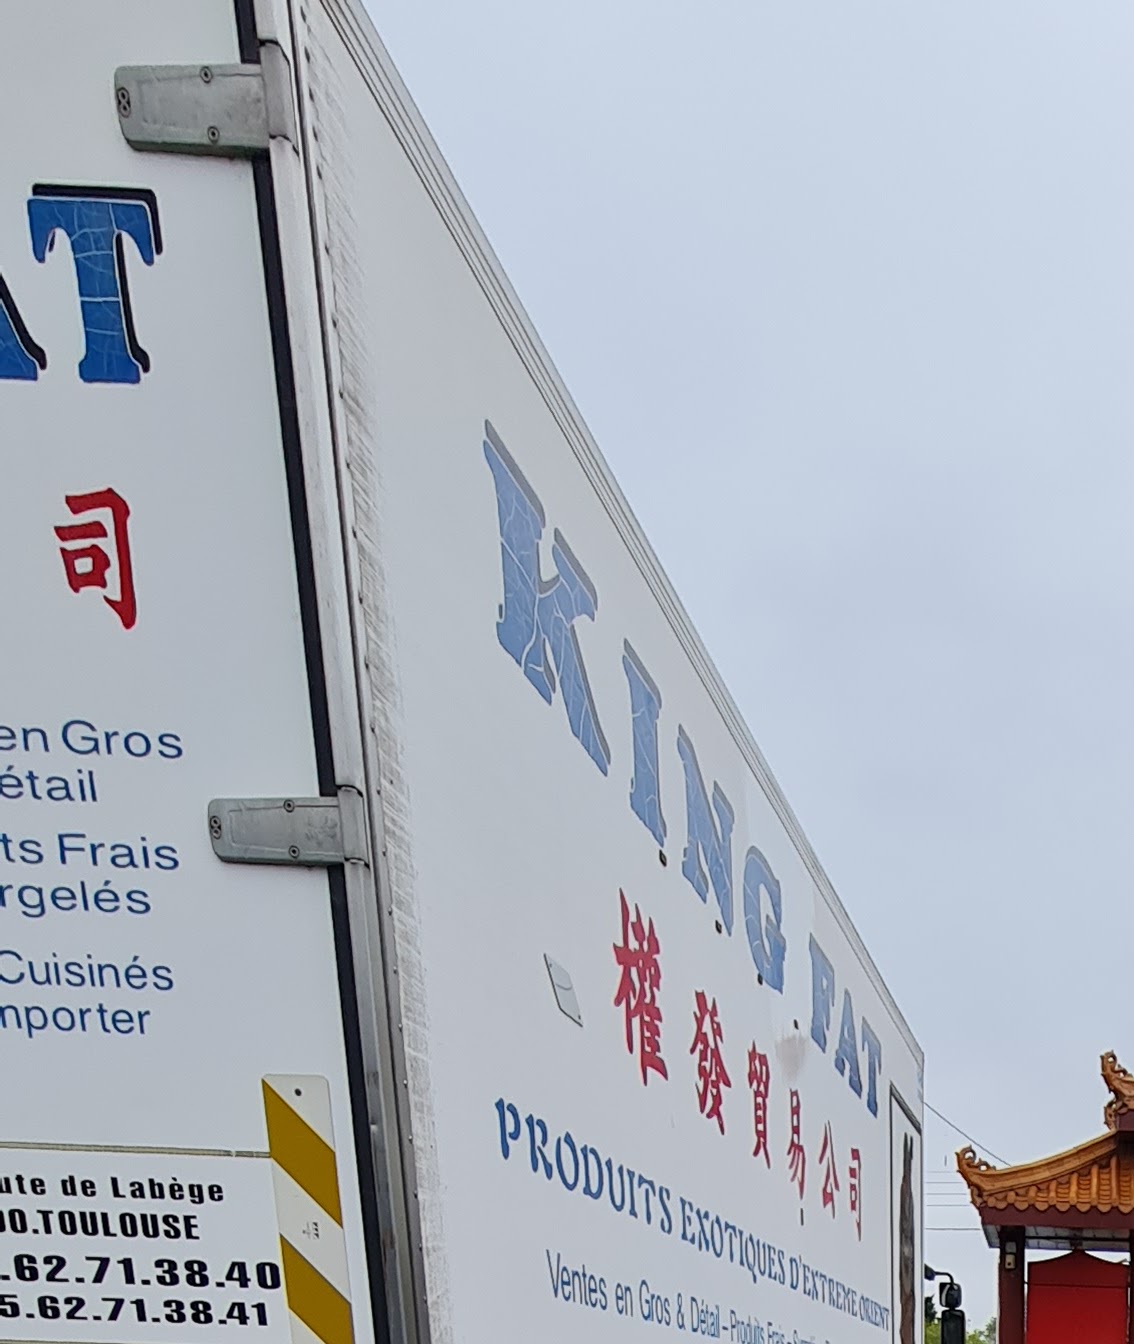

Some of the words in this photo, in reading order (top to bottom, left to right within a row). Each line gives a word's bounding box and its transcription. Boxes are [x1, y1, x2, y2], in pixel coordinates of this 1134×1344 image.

[54, 487, 136, 630] 司
[483, 419, 783, 994] KING
[62, 720, 183, 759] Gros
[58, 833, 180, 870] Frais
[0, 950, 174, 990] Cuisinés
[61, 1175, 96, 1197] de
[110, 1176, 224, 1204] Labège
[495, 1097, 672, 1235] PRODUITS
[679, 1197, 785, 1285] EXOTIQUES
[789, 1254, 857, 1317] D'EXTREME
[859, 1294, 889, 1332] ORIENT
[546, 1249, 607, 1310] Ventes
[615, 1283, 633, 1317] en
[639, 1279, 671, 1326] Gros
[677, 1292, 686, 1330] &
[690, 1296, 720, 1338] Détail
